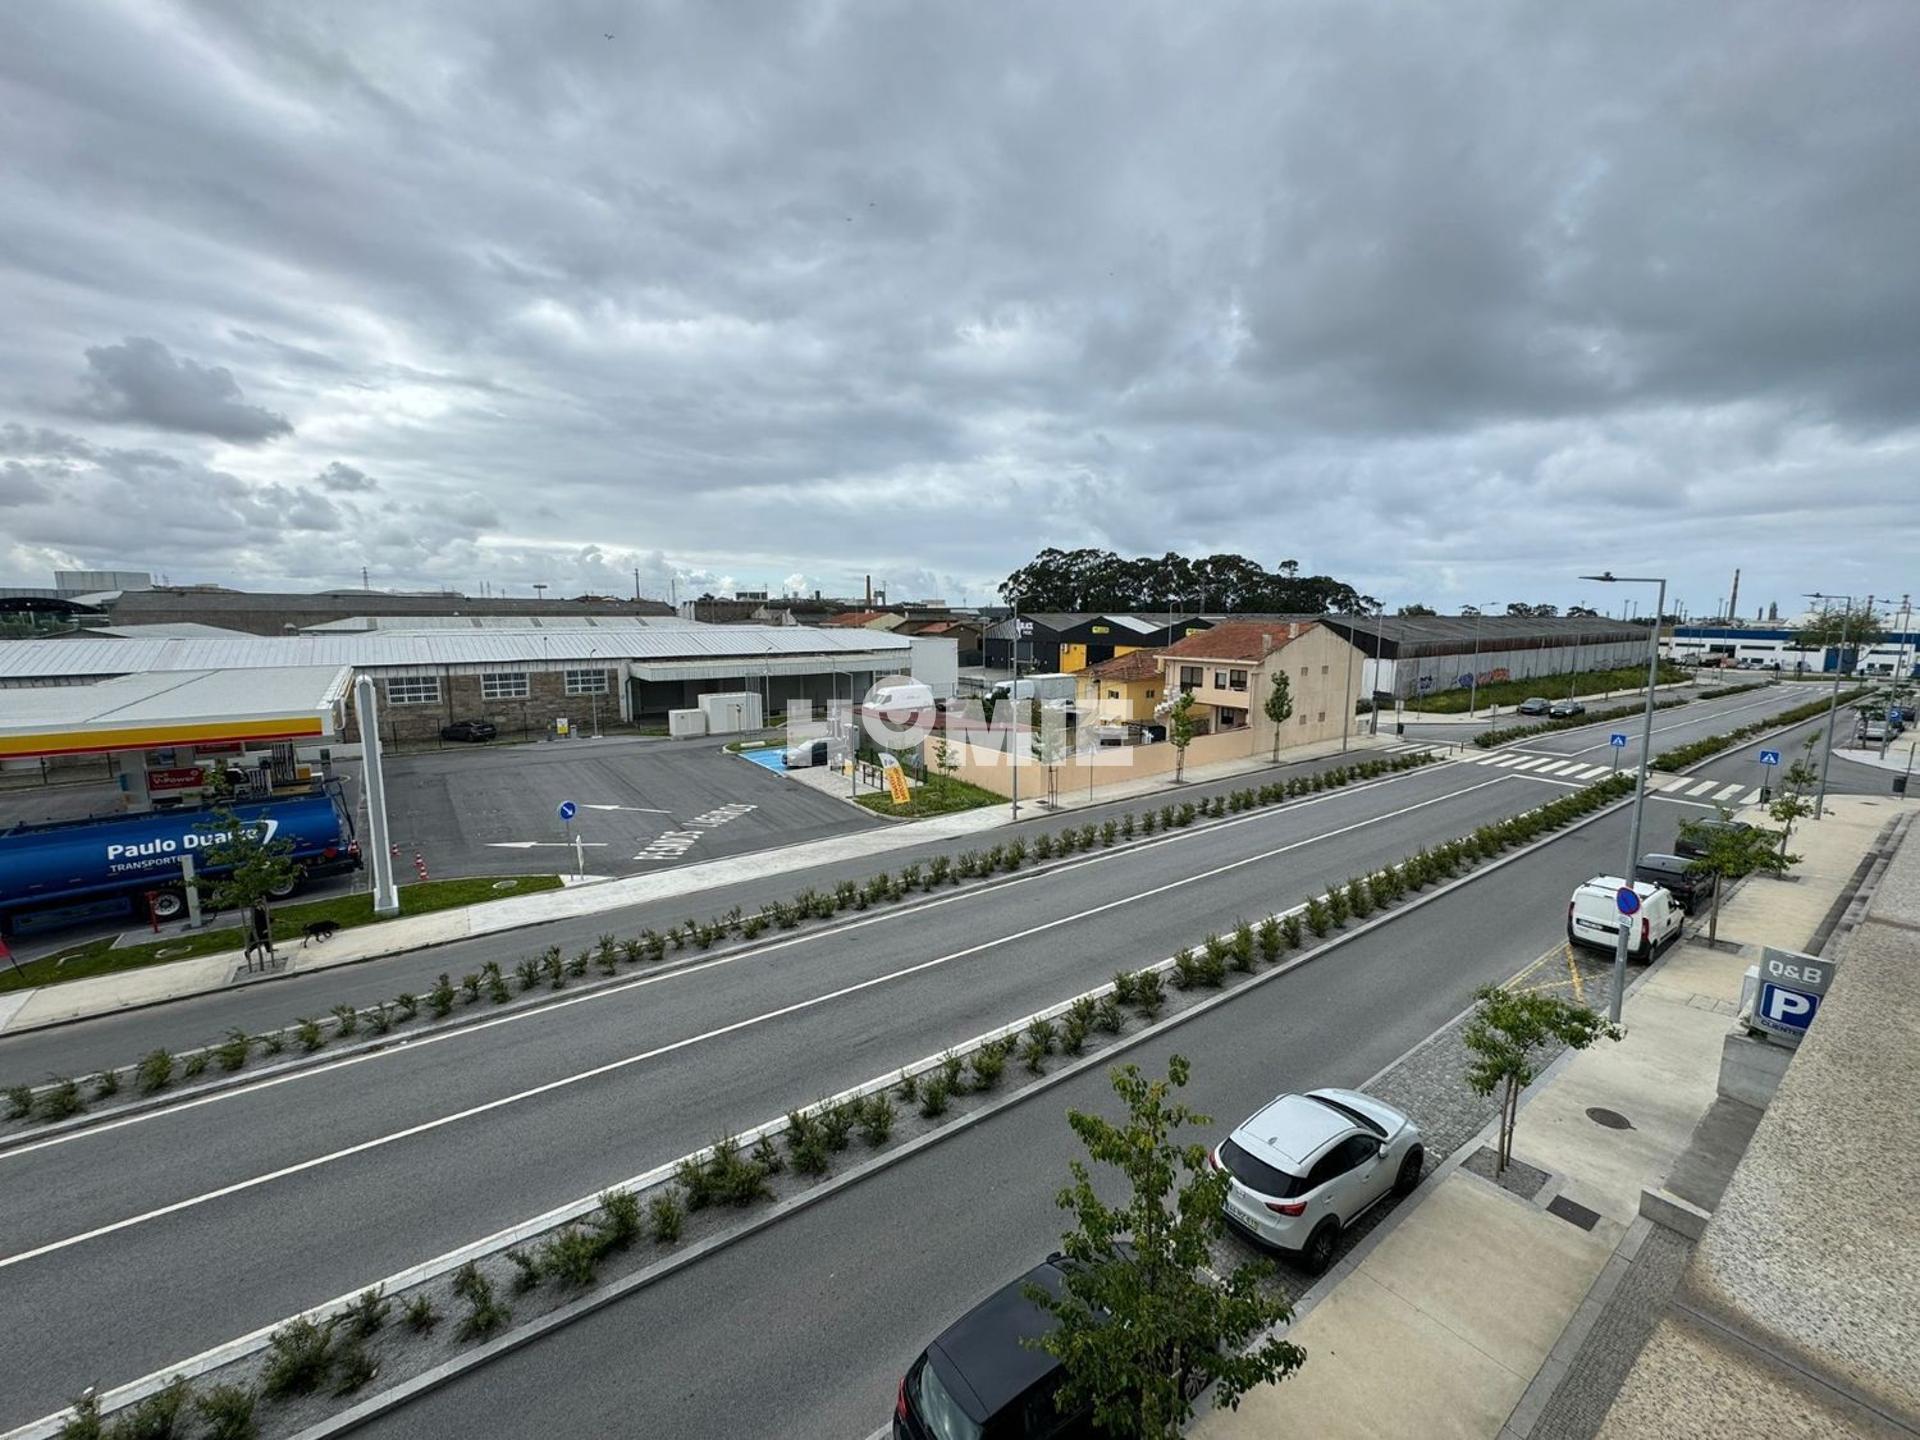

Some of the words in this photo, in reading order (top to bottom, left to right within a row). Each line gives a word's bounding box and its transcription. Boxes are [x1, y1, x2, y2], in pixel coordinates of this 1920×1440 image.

[107, 839, 176, 860] Paulo
[110, 856, 184, 873] TRANSPORTE
[1768, 960, 1823, 984] Q&B
[1769, 988, 1810, 1020] P
